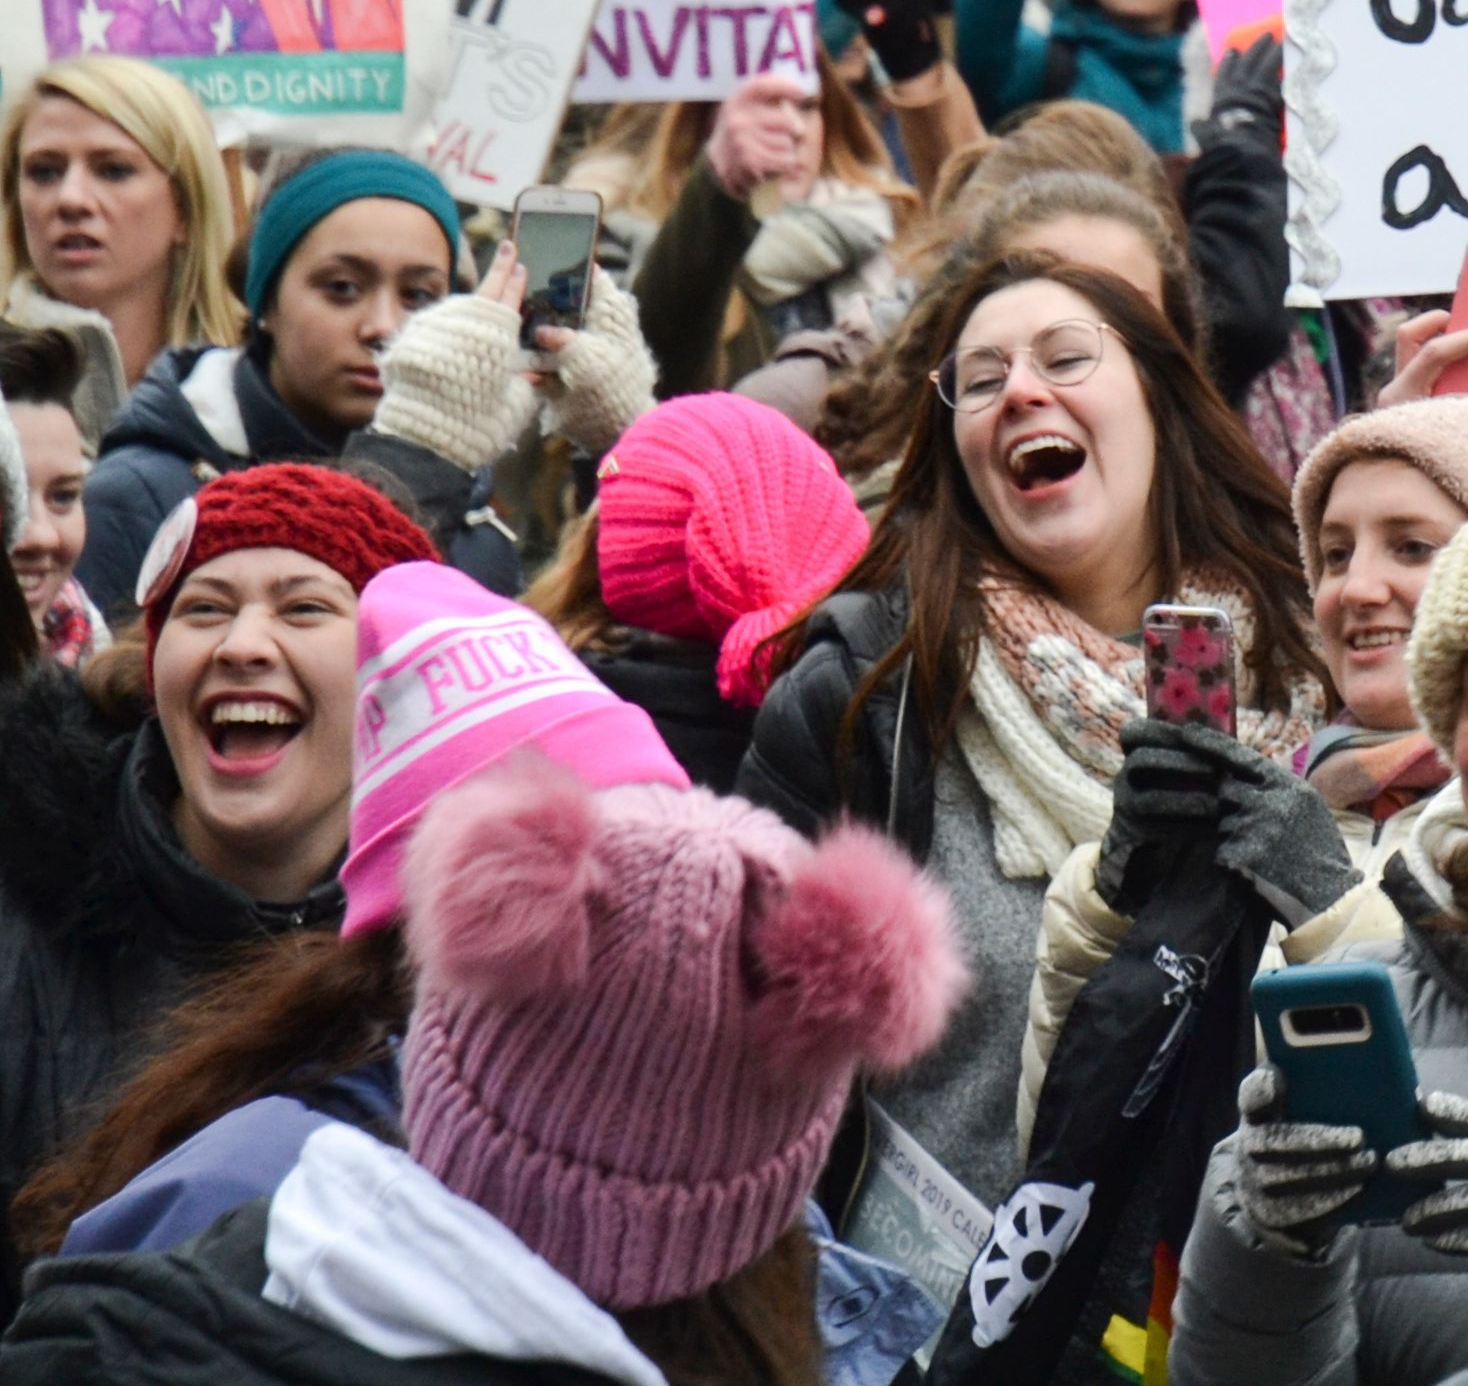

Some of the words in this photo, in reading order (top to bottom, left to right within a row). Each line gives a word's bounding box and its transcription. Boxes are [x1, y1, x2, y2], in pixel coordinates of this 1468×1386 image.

[191, 71, 237, 103] ND
[245, 67, 391, 105] DIGNITY
[415, 630, 560, 716] FUCK
